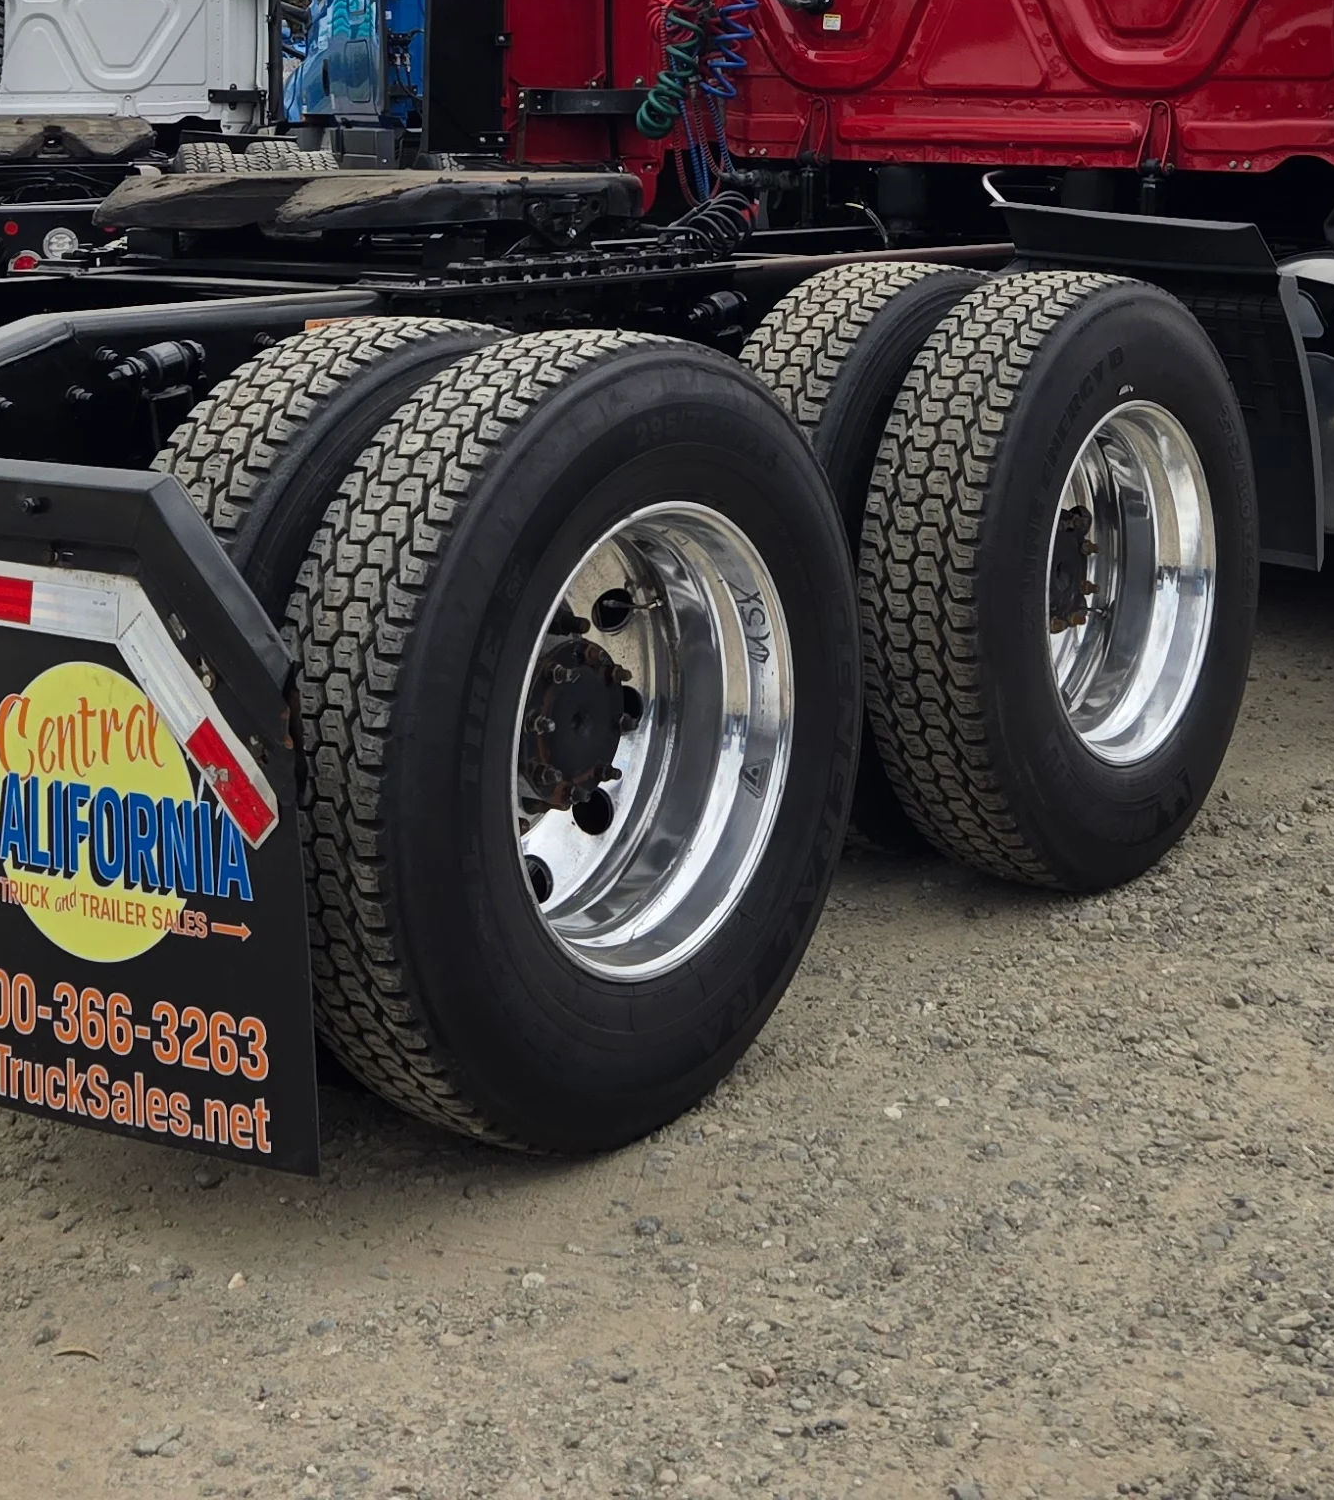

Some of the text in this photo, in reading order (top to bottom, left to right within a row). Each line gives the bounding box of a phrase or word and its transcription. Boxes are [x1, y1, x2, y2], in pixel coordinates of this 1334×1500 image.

[1034, 360, 1107, 492] ENERGY
[0, 876, 208, 939] TRUCK and TRAILER SALES
